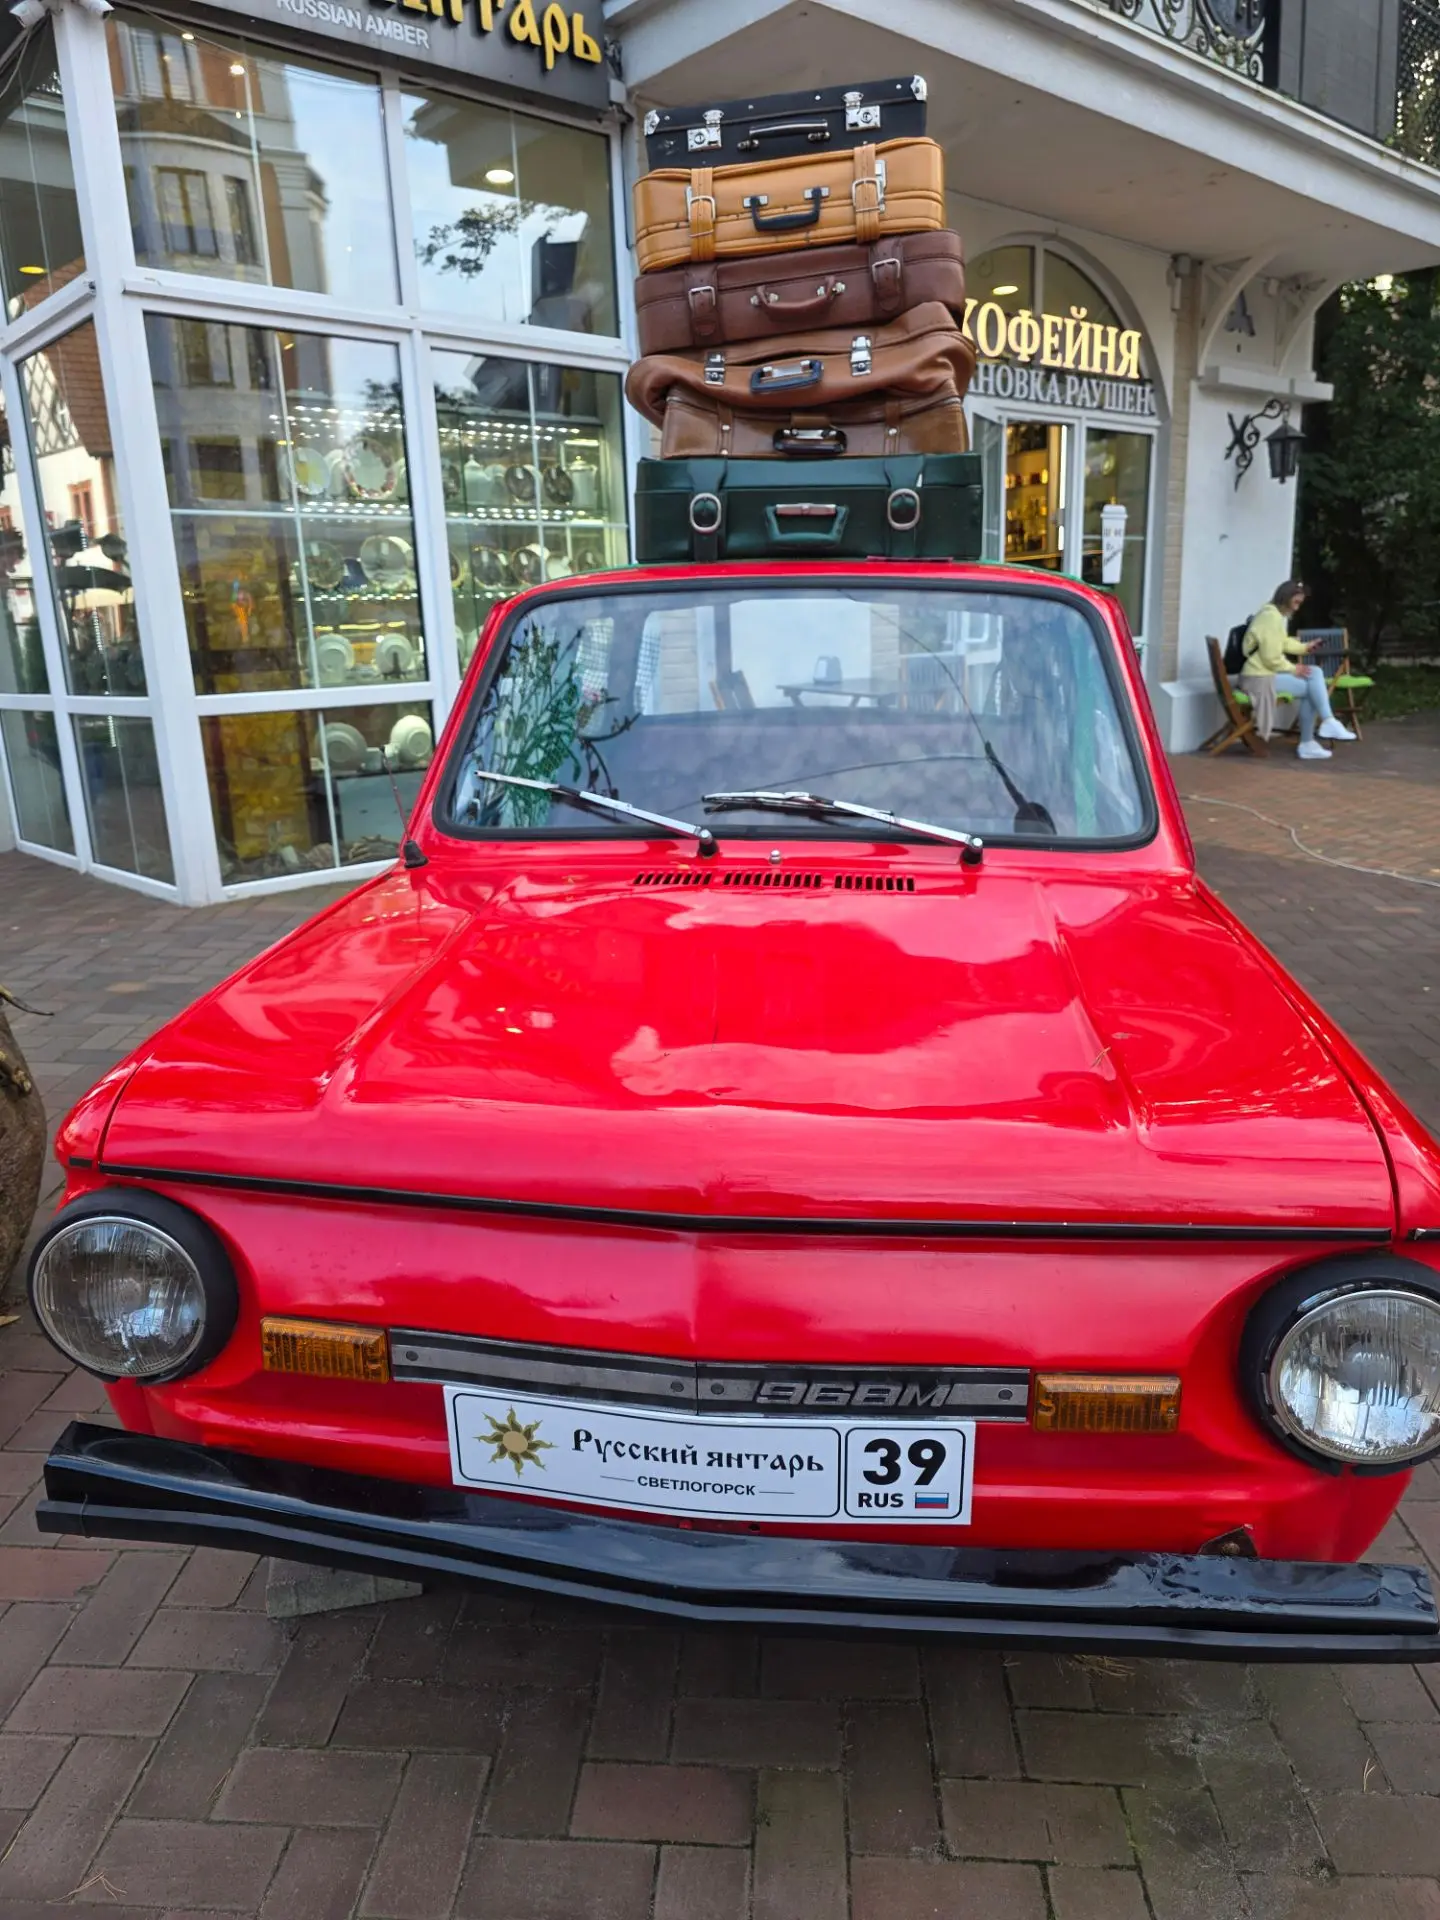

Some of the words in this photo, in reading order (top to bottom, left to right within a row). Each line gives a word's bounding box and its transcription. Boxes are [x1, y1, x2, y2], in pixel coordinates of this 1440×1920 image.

[365, 14, 429, 49] AMBER
[385, 0, 602, 70] тарь
[572, 1428, 699, 1466] Русский
[706, 1451, 824, 1478] янтарь
[862, 1438, 947, 1486] 39
[637, 1475, 756, 1496] СВЕТЛОГОРСК
[858, 1492, 904, 1508] RUS
